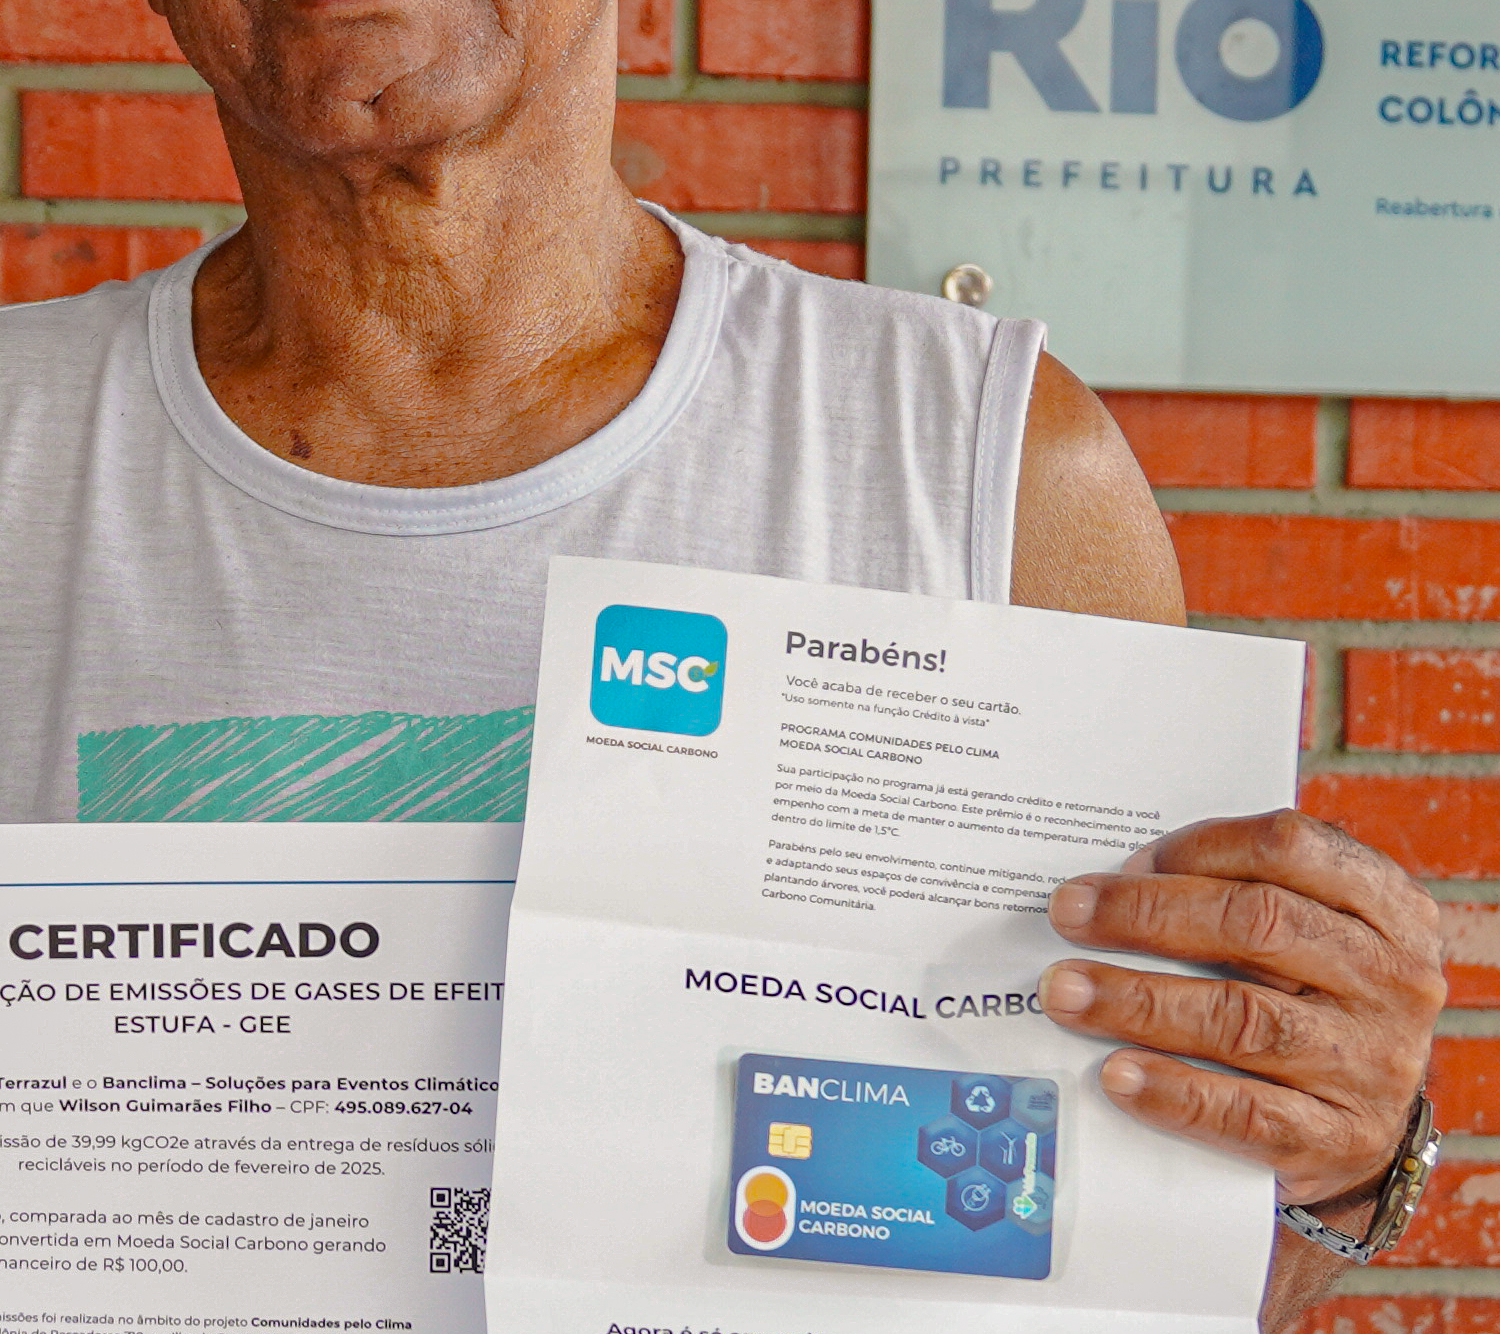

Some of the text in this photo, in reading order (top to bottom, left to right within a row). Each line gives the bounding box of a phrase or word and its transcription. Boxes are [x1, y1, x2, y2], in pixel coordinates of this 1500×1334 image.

[939, 157, 1320, 199] PREFEITURA
[1374, 196, 1495, 221] Reabertura
[785, 630, 947, 674] Parabéns!
[599, 646, 712, 694] MSC
[786, 673, 1022, 716] Você acaba de receber o seu cartão.
[585, 734, 719, 760] MOEDA SOCIAL CARBONO
[8, 920, 380, 961] CERTIFICADO
[65, 982, 101, 1003] DE
[110, 976, 242, 1002] EMISSÕES
[251, 981, 287, 1001] DE
[294, 981, 381, 1002] GASES
[389, 981, 425, 1002] DE
[434, 981, 504, 1002] EFEIT
[685, 967, 807, 1002] MOEDA
[815, 981, 927, 1021] SOCIAL
[114, 1014, 216, 1035] ESTUFA
[239, 1014, 292, 1035] GEE
[71, 1079, 82, 1091] e
[86, 1078, 98, 1090] o
[102, 1074, 187, 1090] Banclima
[205, 1075, 286, 1094] Soluções
[291, 1079, 331, 1094] para
[337, 1076, 410, 1091] Eventos
[414, 1075, 499, 1093] Climático
[753, 1071, 911, 1108] BANCLIMA
[800, 1198, 936, 1226] MOEDA SOCIAL
[798, 1218, 891, 1241] CARBONO
[83, 1235, 112, 1249] em
[117, 1233, 175, 1250] Moeda
[179, 1234, 230, 1251] Social
[234, 1235, 309, 1252] Carbono
[312, 1236, 387, 1256] gerando
